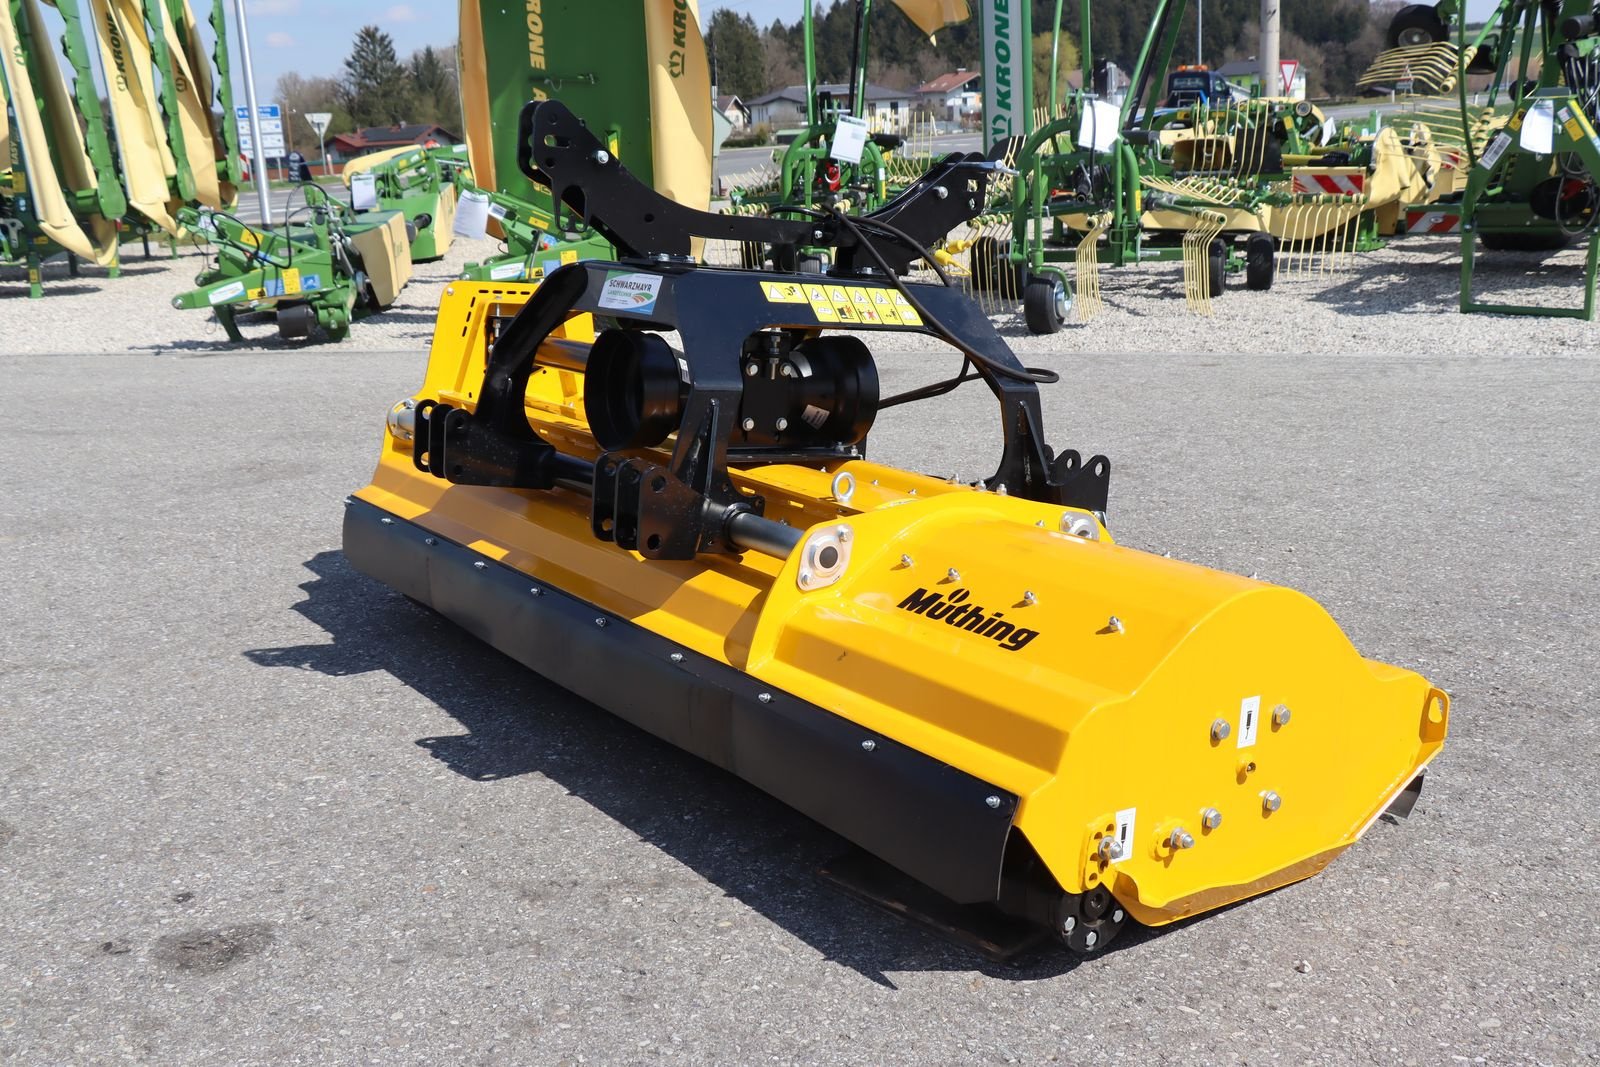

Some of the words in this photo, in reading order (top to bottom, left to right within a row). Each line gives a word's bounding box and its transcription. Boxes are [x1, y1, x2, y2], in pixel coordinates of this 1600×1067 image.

[526, 0, 545, 70] RONE
[994, 0, 1011, 111] KRONE
[609, 279, 653, 292] SCHWARZMAYR
